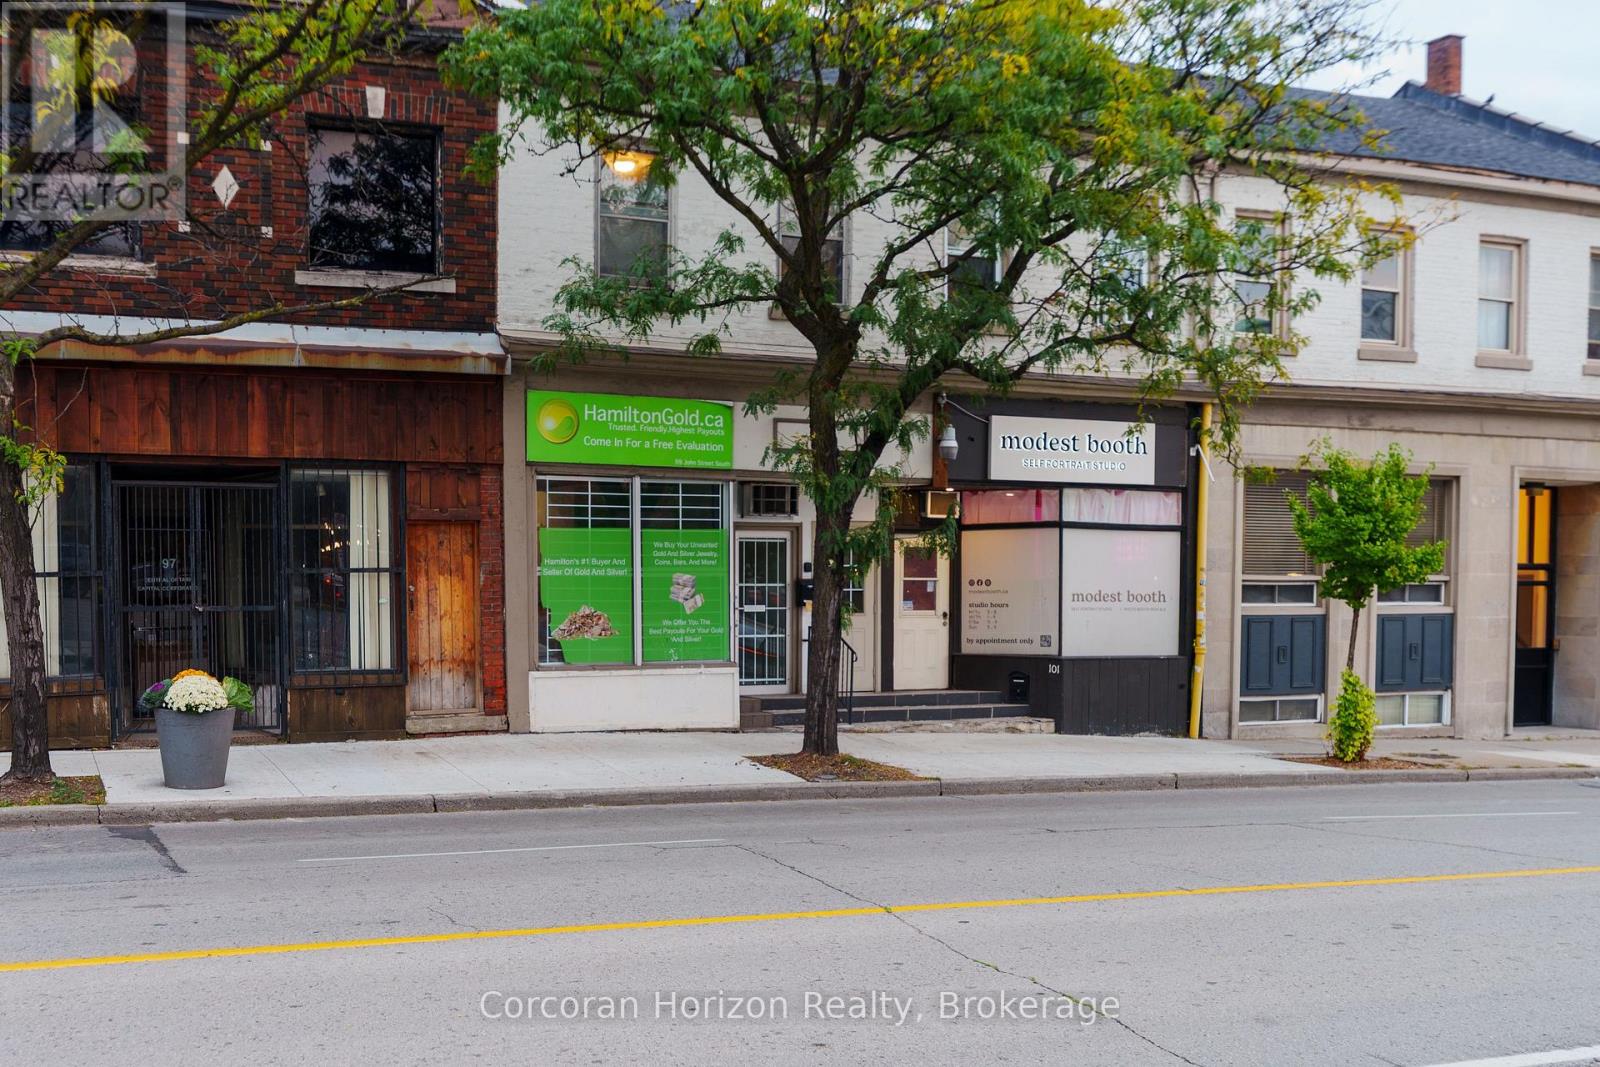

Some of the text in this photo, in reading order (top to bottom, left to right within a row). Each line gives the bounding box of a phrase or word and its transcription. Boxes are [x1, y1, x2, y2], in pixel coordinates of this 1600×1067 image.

[584, 403, 724, 428] HamiltonGold.ca
[697, 427, 724, 437] Payouts
[583, 436, 612, 447] Come
[614, 437, 623, 447] In
[626, 438, 641, 448] For
[653, 439, 673, 450] Free
[676, 440, 724, 452] Evaluation
[1001, 432, 1148, 455] modest booth
[1093, 461, 1126, 471] STUDIO
[162, 558, 176, 569] 97
[544, 558, 579, 566] Hamilton's
[591, 558, 611, 567] Buyer
[543, 568, 628, 576] Seller Of Gold And Silver!
[1072, 589, 1167, 603] modest booth
[1048, 664, 1060, 674] 101
